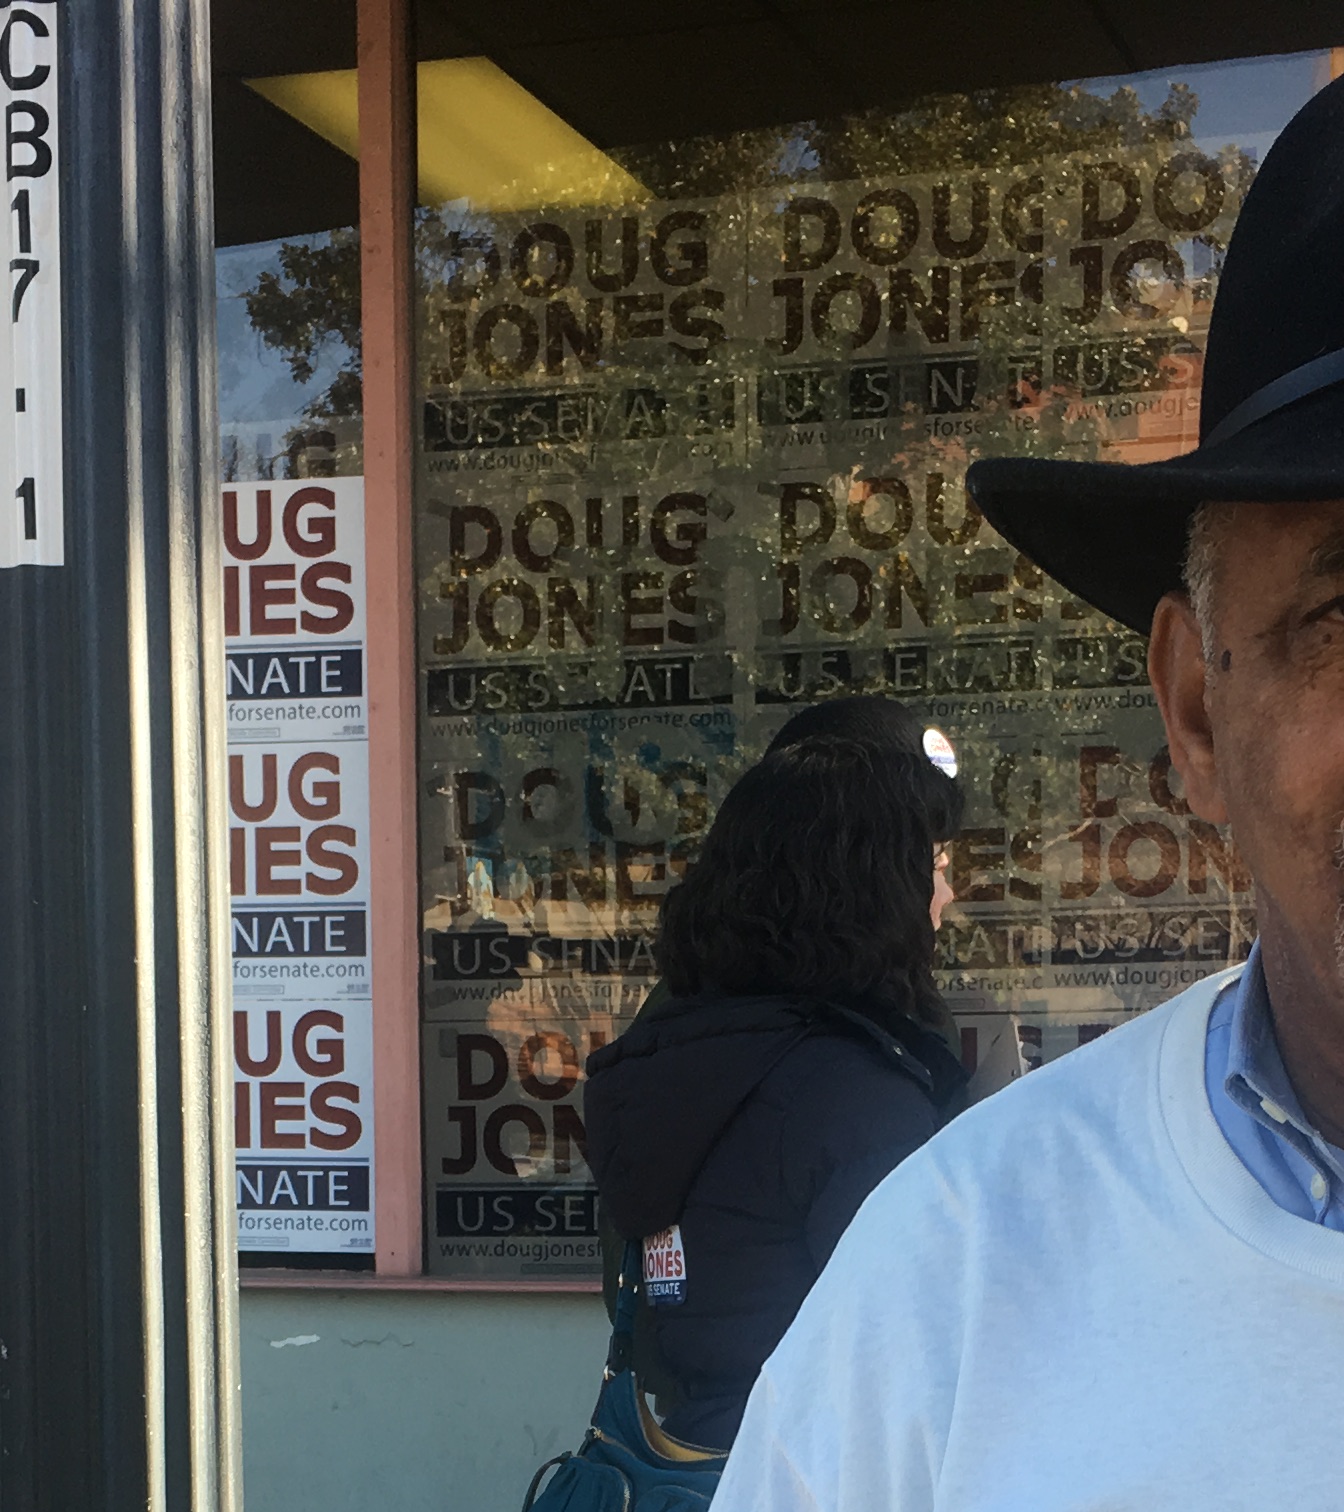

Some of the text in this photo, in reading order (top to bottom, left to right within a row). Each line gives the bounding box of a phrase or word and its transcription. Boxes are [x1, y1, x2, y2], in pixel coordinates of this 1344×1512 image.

[1082, 152, 1225, 241] DO
[447, 210, 709, 305] DOUG
[430, 288, 726, 386] JONES
[444, 403, 506, 446] US
[222, 486, 337, 561] UG
[448, 491, 709, 577] DOUG
[778, 472, 983, 555] DOU
[432, 568, 726, 655] JONES
[226, 655, 343, 696] NATE
[447, 671, 508, 711] US
[227, 702, 362, 723] forsenate.com
[228, 751, 341, 823] UG
[1059, 819, 1255, 900] JON
[231, 915, 347, 953] NATE
[452, 935, 657, 975] US SENA
[232, 960, 365, 979] forsenate.com
[232, 1009, 345, 1078] UG
[457, 1030, 606, 1101] DO
[441, 1104, 588, 1175] JON
[236, 1170, 351, 1207] NATE
[237, 1212, 369, 1233] forsenate.com
[456, 1196, 514, 1232] US
[439, 1240, 602, 1262] www.dougjones
